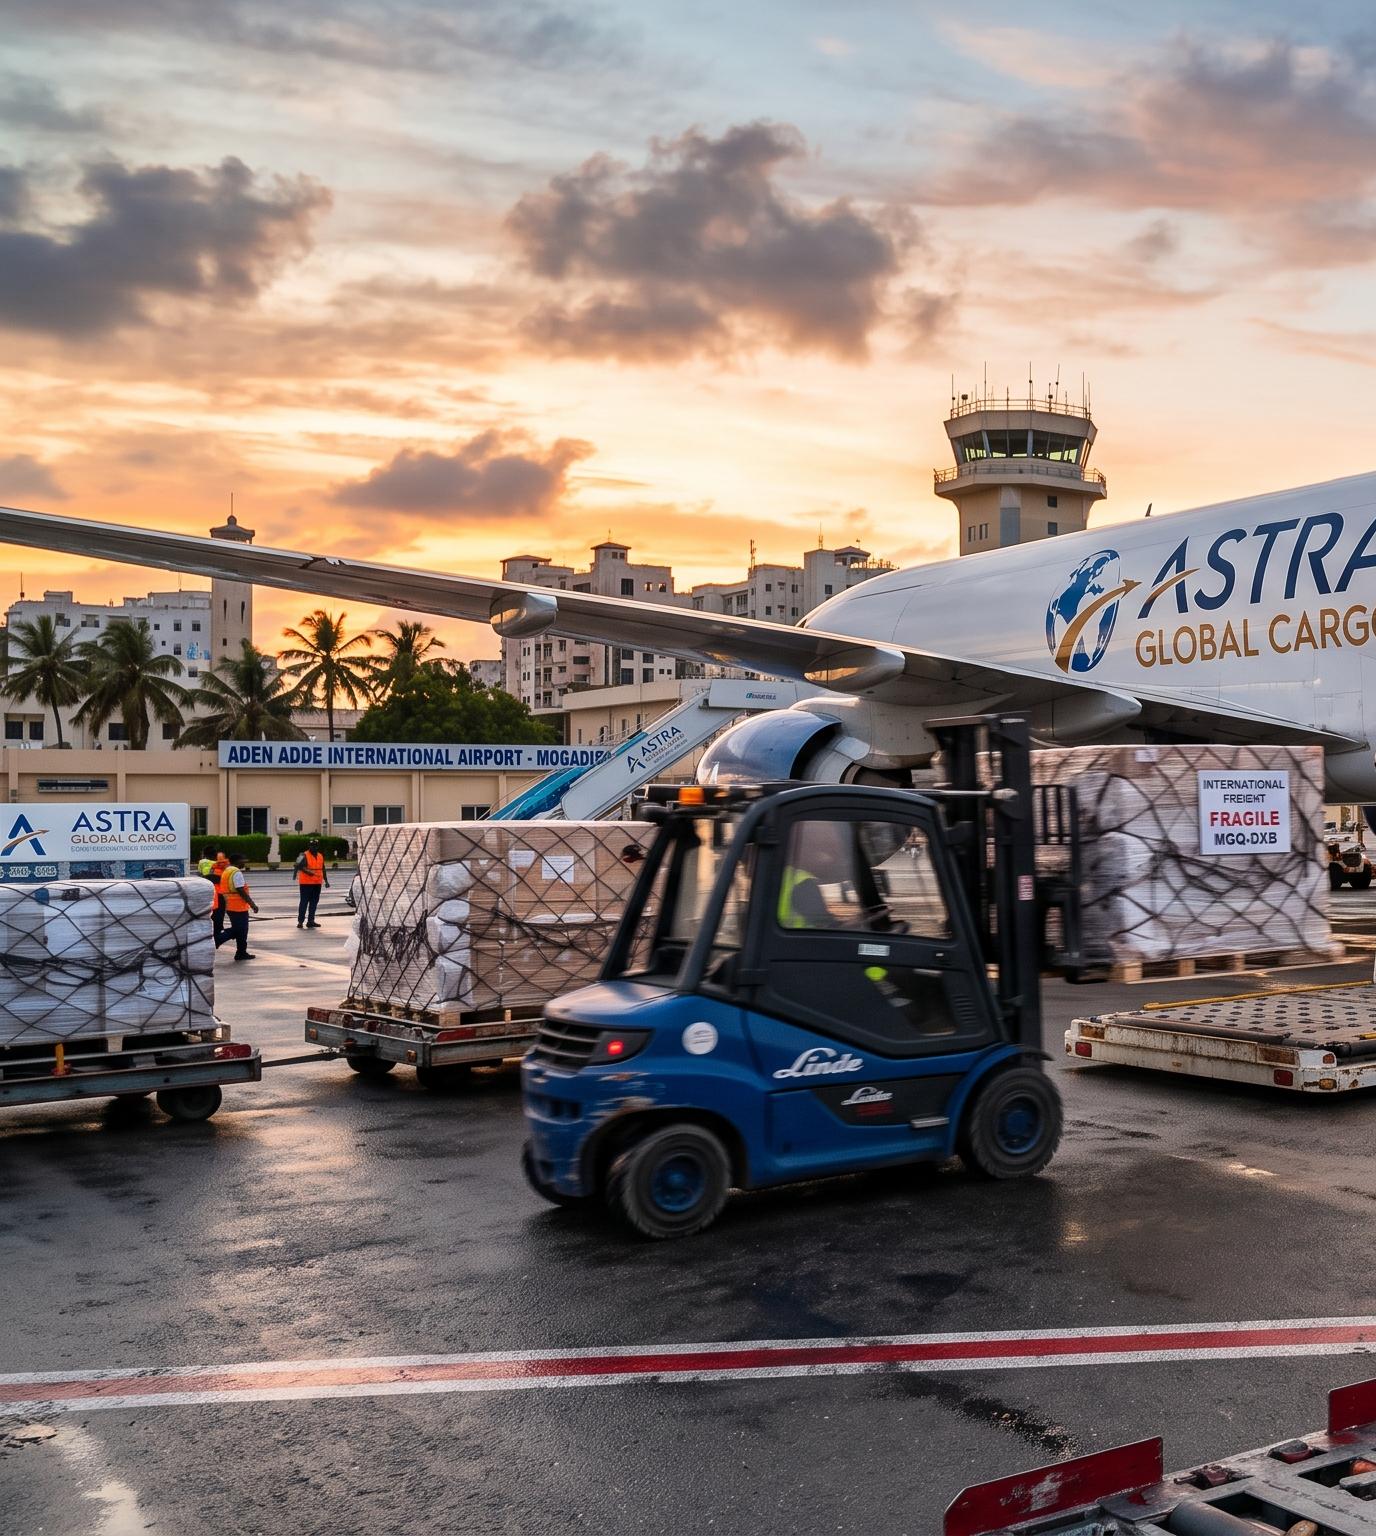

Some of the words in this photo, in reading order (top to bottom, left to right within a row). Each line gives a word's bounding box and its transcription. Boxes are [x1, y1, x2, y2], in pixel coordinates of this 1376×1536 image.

[1135, 618, 1260, 668] GLOBAL
[641, 726, 681, 757] ASTRA
[228, 745, 273, 764] ADEN
[278, 746, 322, 764] ADDE
[328, 747, 453, 766] INTERNATIONAL
[457, 748, 523, 766] AIRPORT
[1203, 779, 1286, 790] INTERNATIONAL
[71, 810, 175, 832] ASTRA
[1210, 811, 1280, 827] FRAGILE
[71, 834, 124, 844] GLOBAL
[128, 833, 177, 843] CARGO
[772, 1047, 864, 1079] Linde
